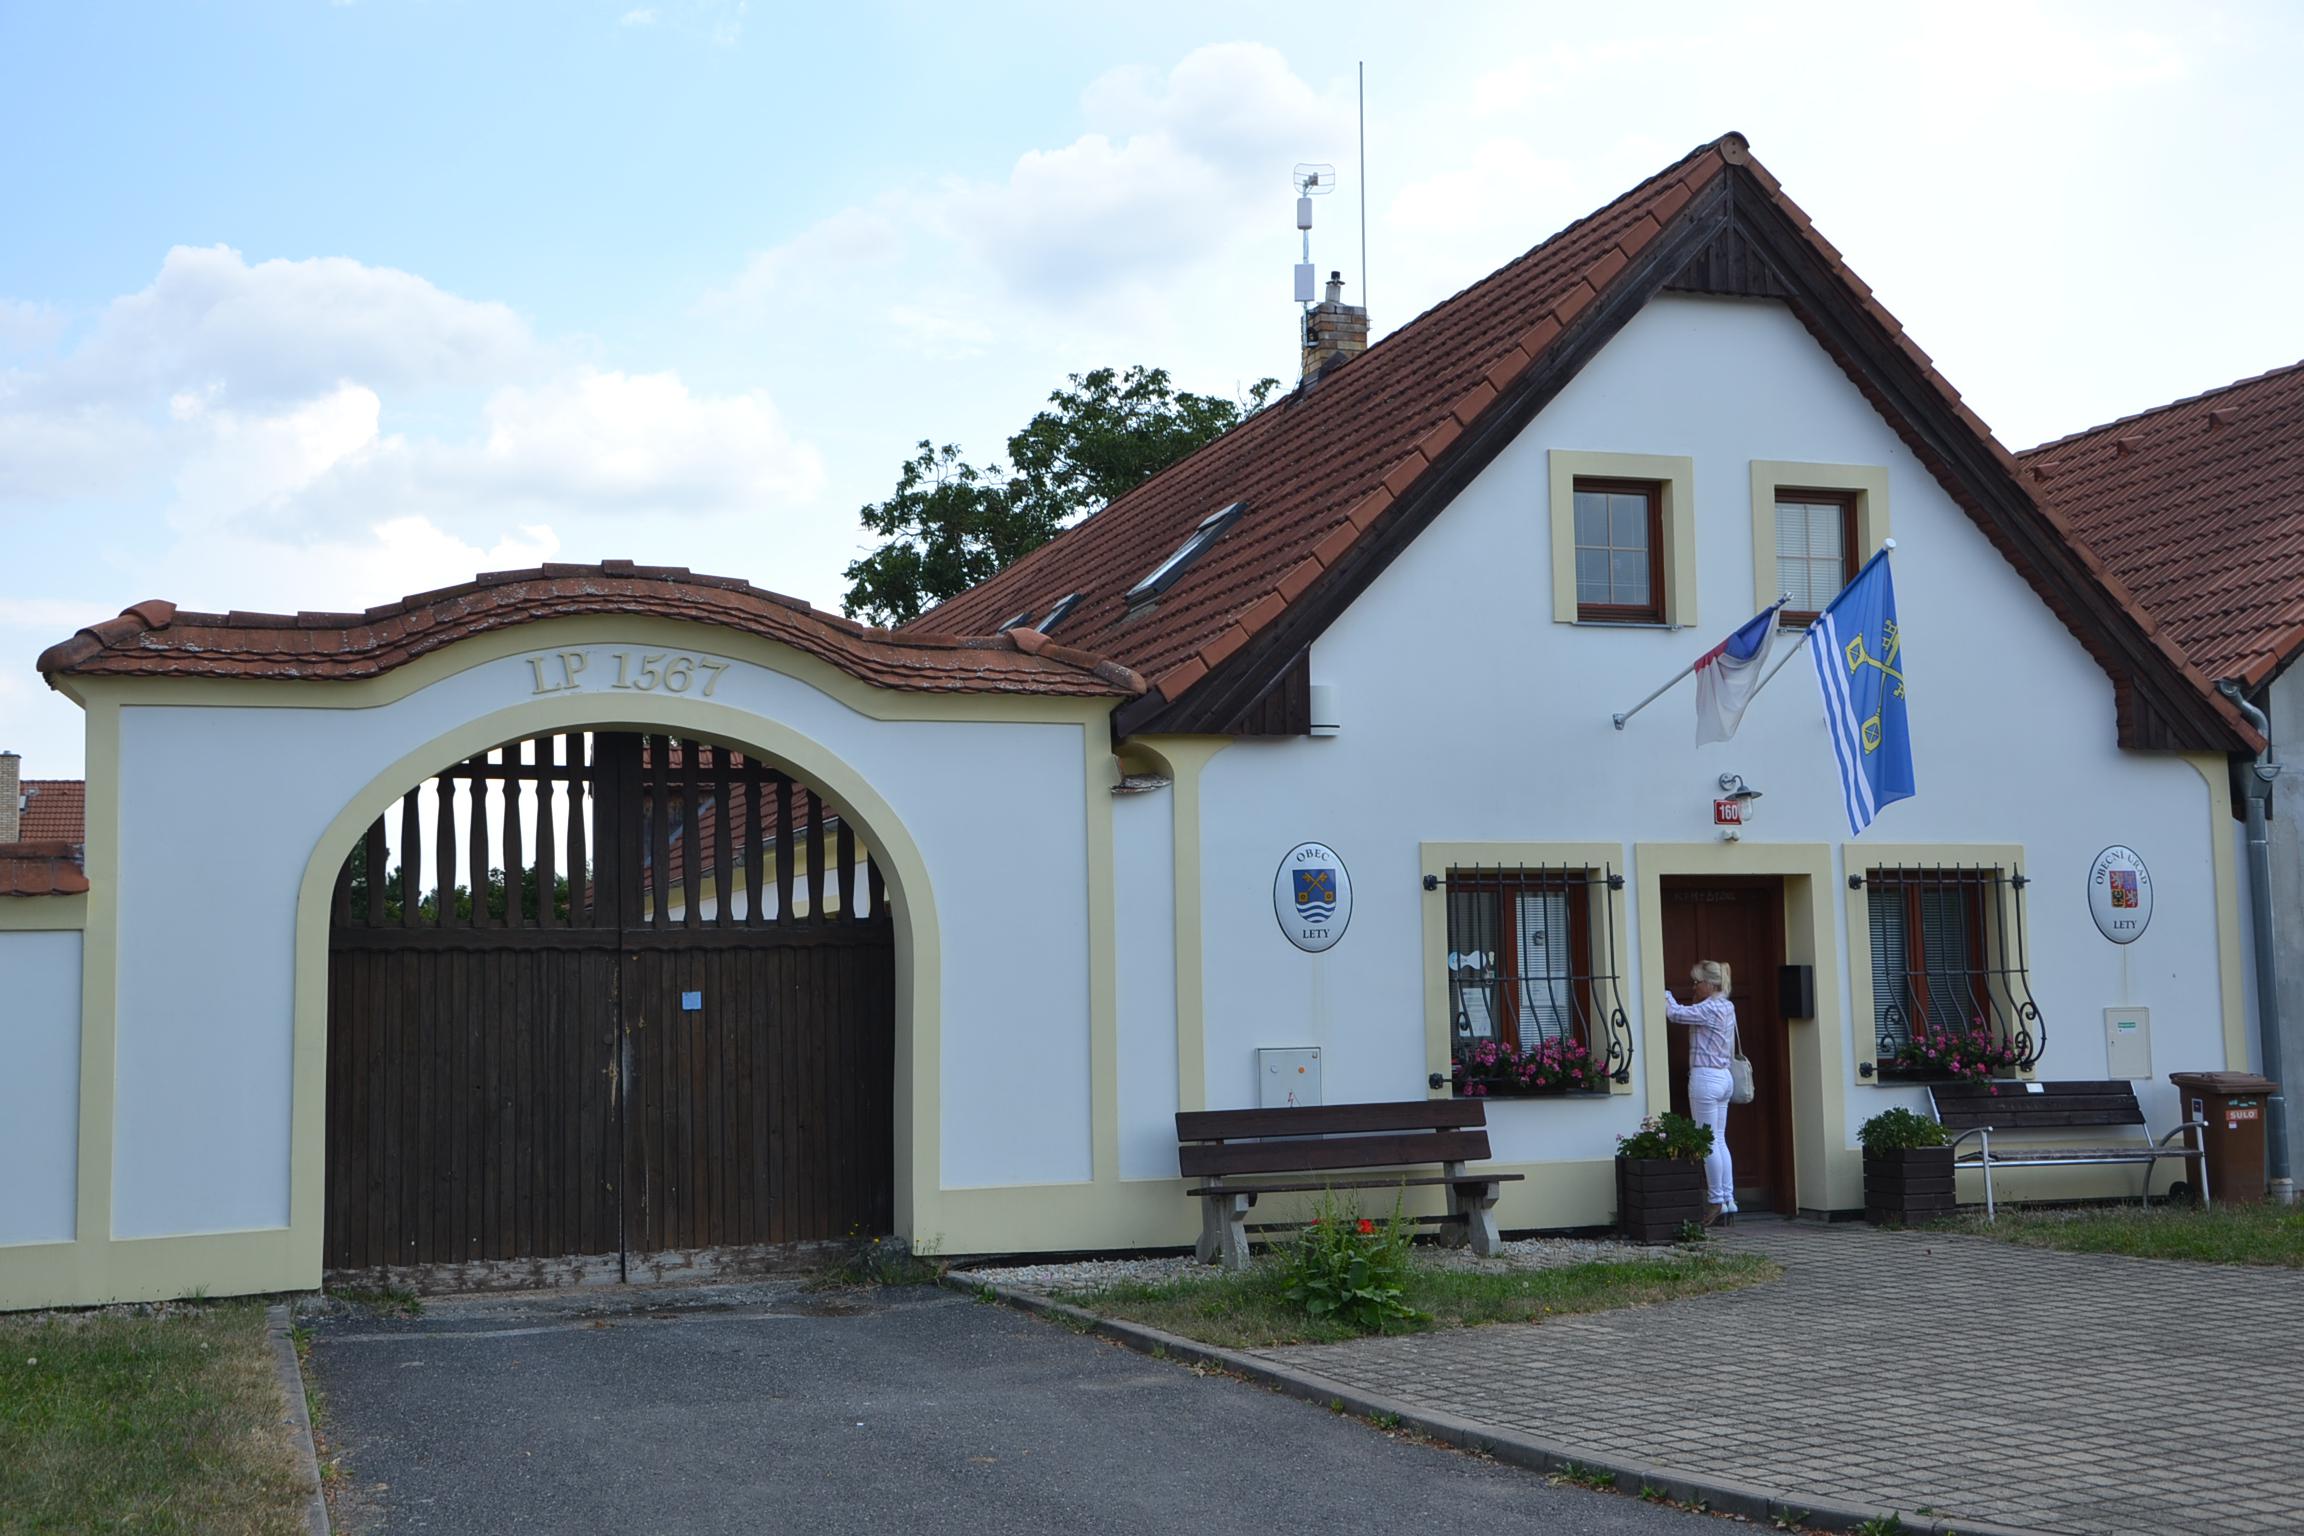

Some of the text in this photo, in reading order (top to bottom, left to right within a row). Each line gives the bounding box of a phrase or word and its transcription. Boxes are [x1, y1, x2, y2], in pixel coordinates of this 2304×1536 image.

[526, 651, 730, 697] LP 1567
[1719, 804, 1738, 820] 160
[1296, 848, 1330, 863] OBEC
[2113, 919, 2137, 930] LETY
[1302, 928, 1330, 939] LETY
[2229, 1110, 2256, 1119] SULO
